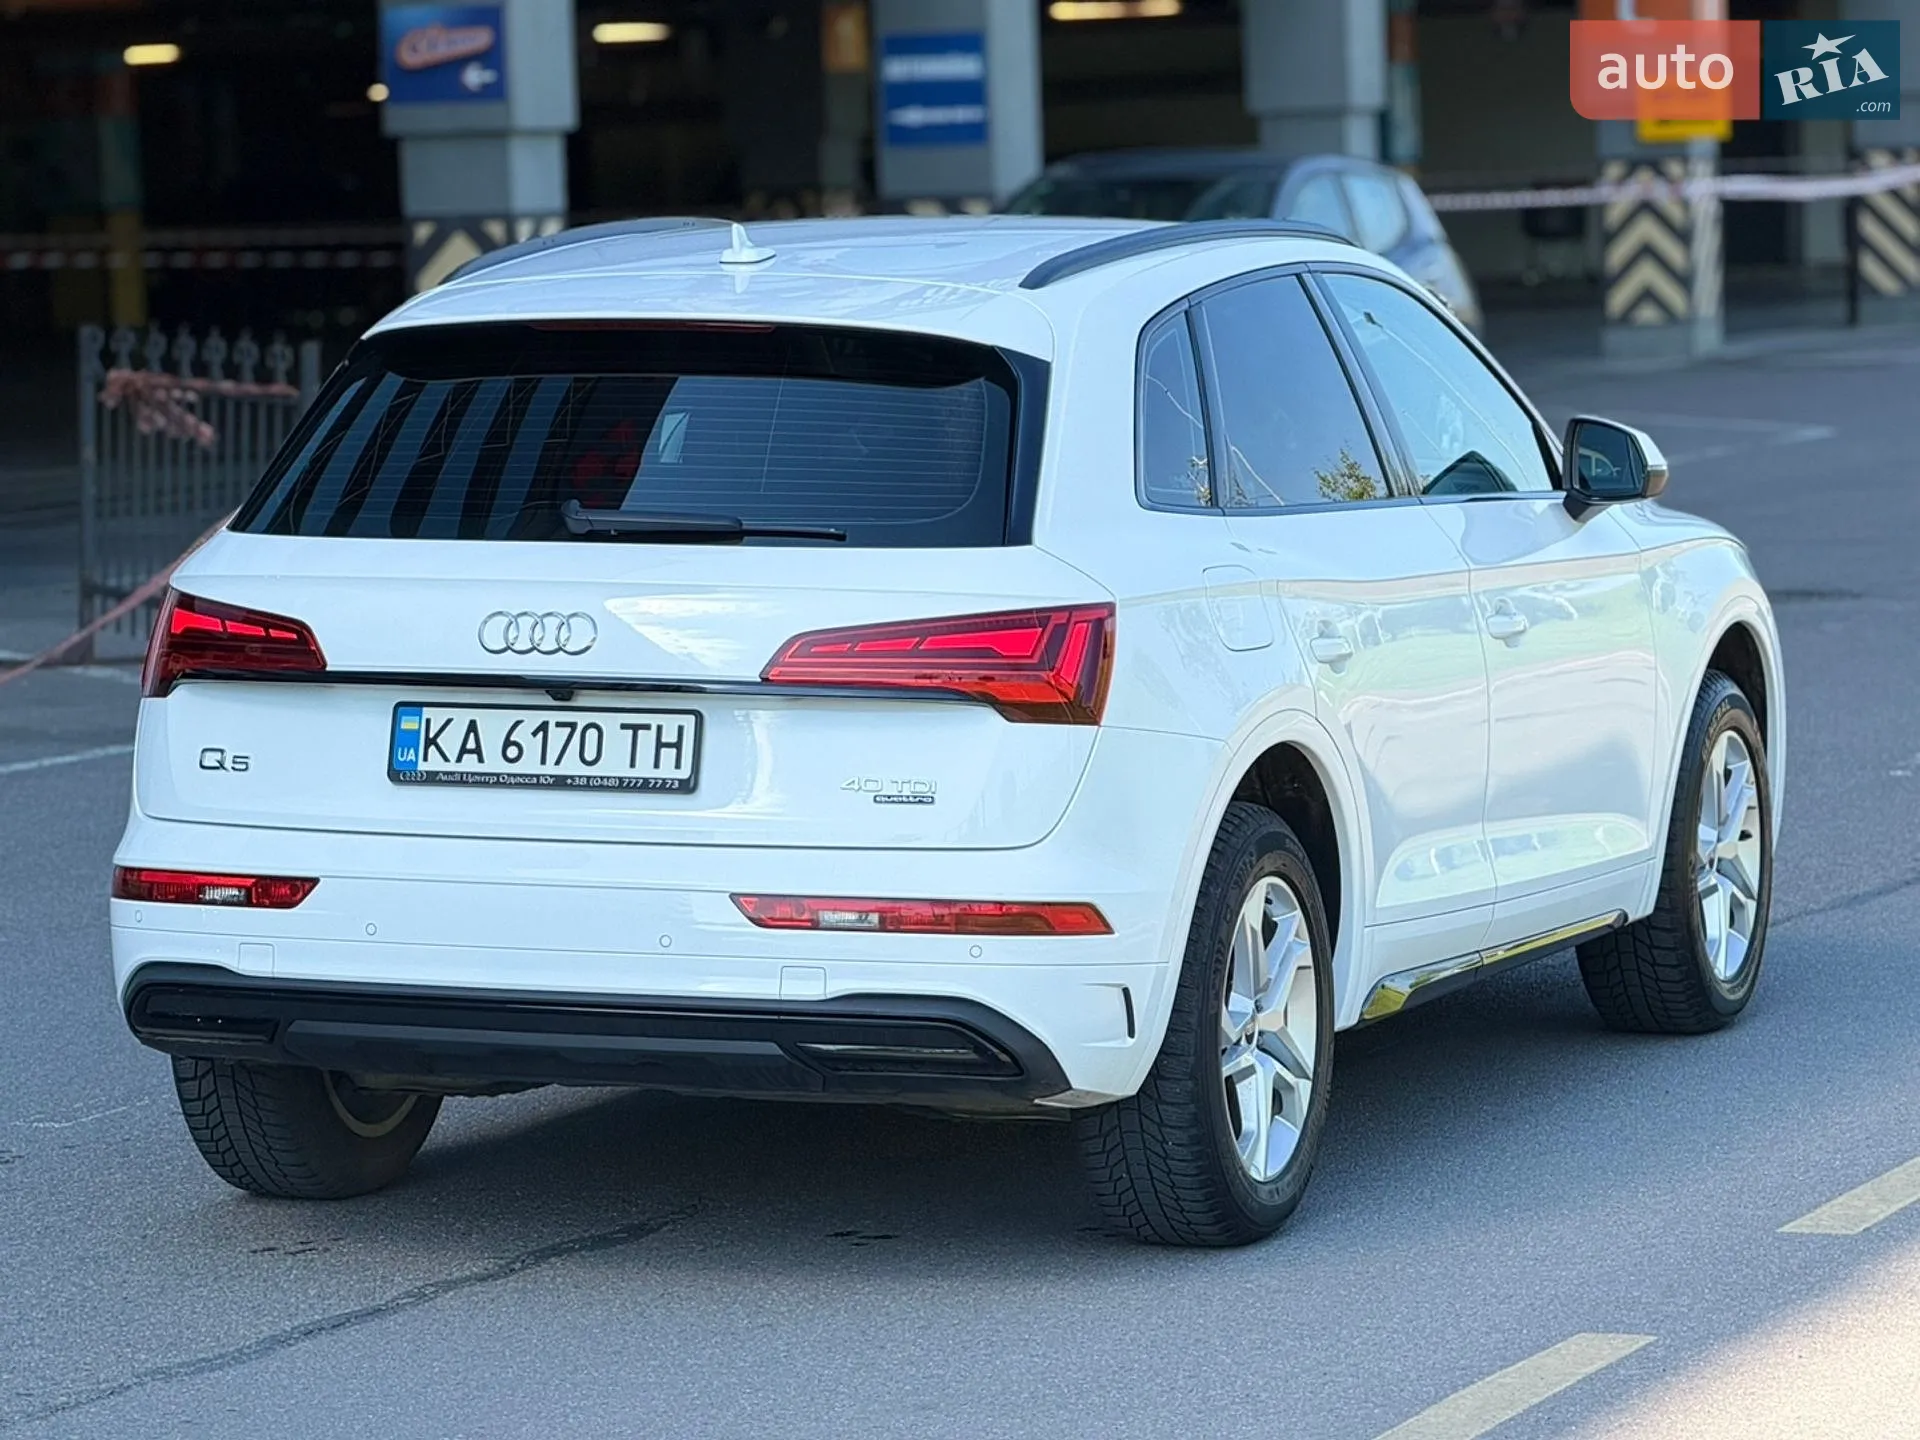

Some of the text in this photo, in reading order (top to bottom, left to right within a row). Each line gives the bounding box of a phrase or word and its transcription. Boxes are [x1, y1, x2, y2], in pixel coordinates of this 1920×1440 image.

[423, 717, 685, 770] KA 6170 TH
[199, 747, 250, 773] Q5
[397, 746, 417, 763] UA
[436, 772, 461, 782] Audi
[566, 776, 588, 786] +38
[589, 777, 620, 788] (048)
[622, 778, 644, 788] 777
[648, 779, 662, 789] 77
[665, 780, 680, 789] 73
[839, 776, 938, 795] 40 TDI
